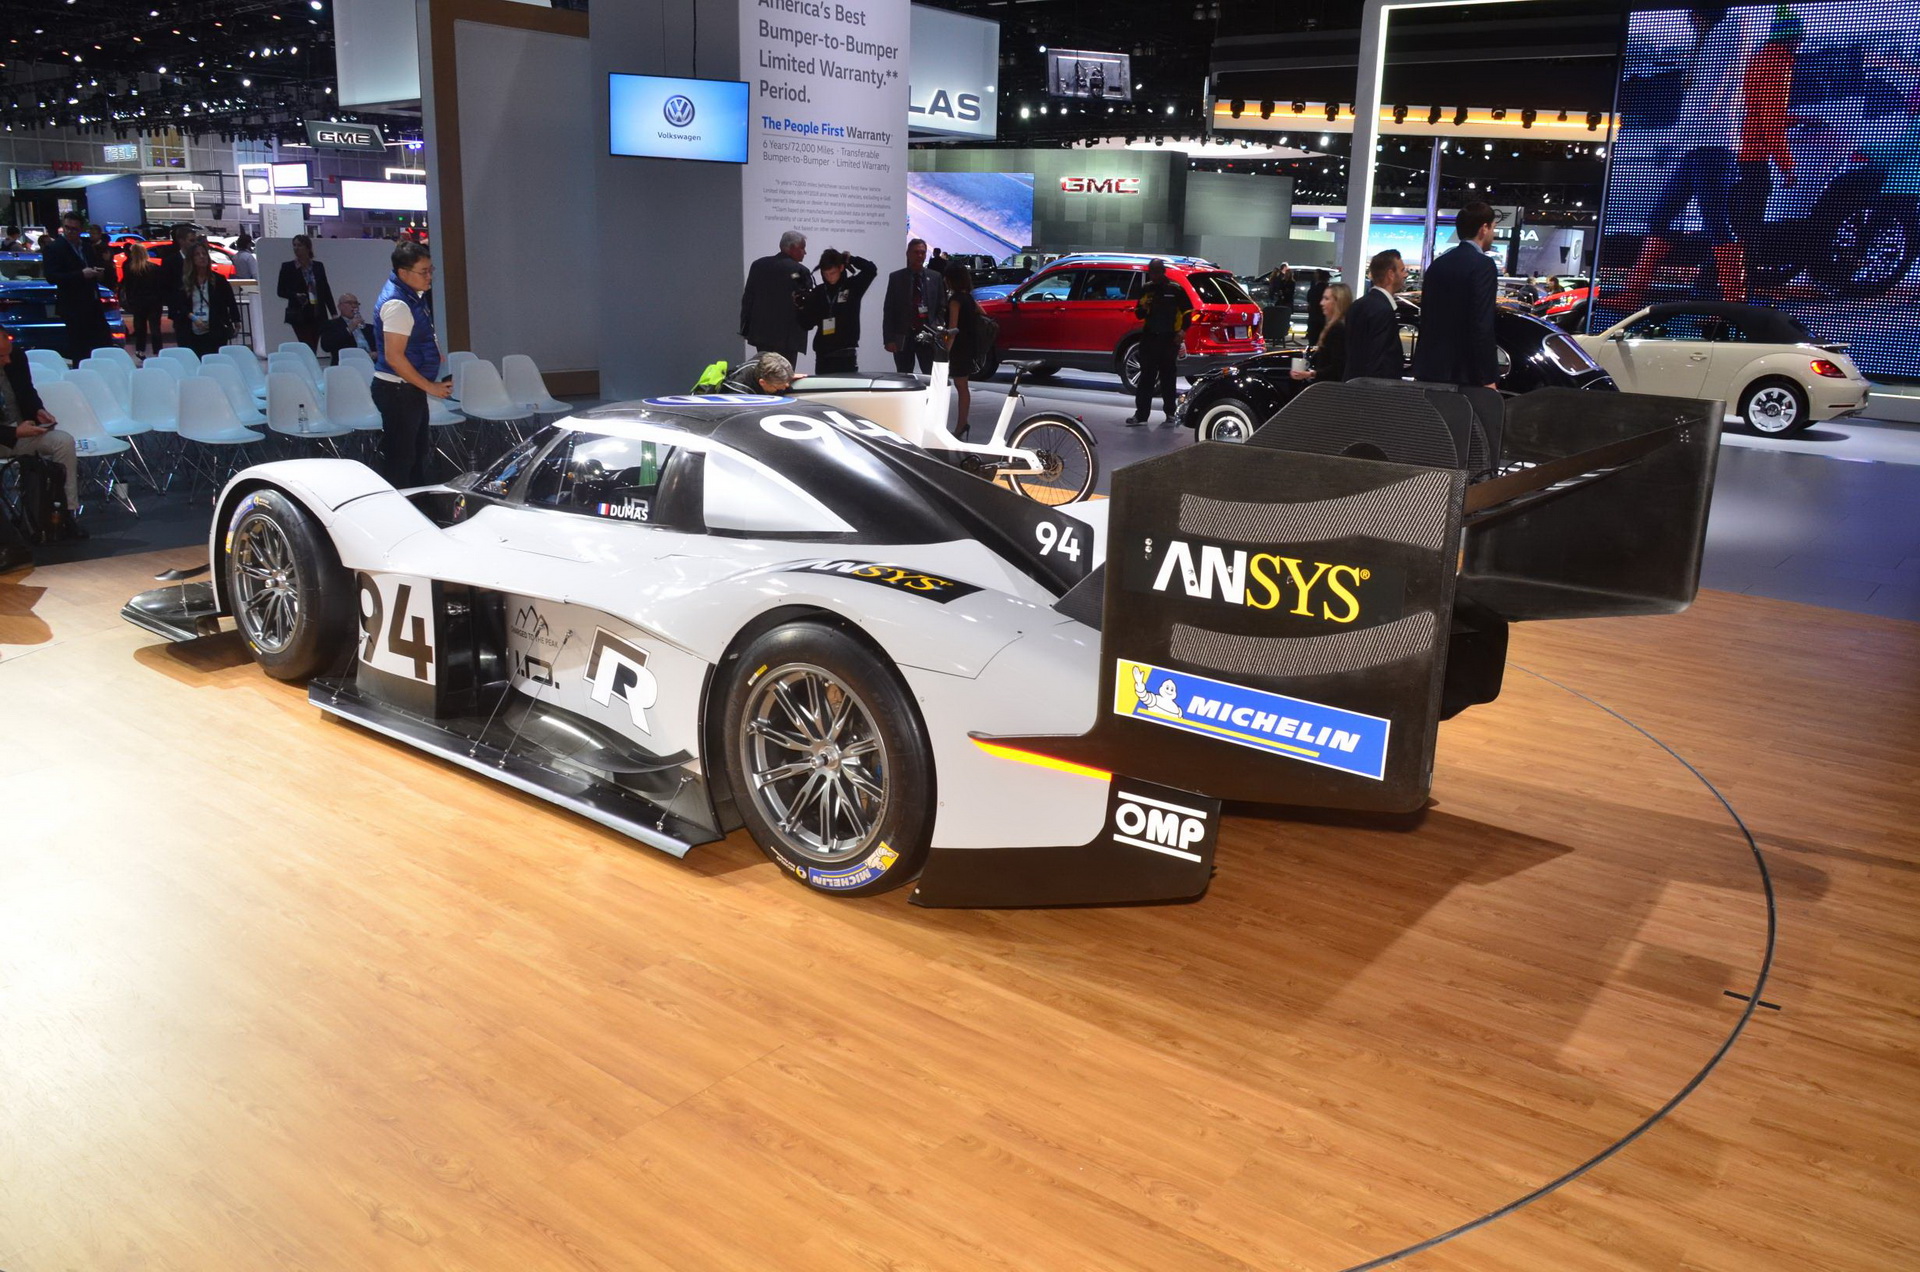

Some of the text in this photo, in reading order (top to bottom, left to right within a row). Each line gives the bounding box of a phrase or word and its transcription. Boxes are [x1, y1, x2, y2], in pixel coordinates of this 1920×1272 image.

[835, 4, 866, 26] Best
[759, 19, 899, 61] Bumper-to-Bumper
[759, 49, 815, 75] Limited
[760, 80, 811, 103] Period.
[909, 85, 981, 121] LAS
[317, 130, 371, 146] GMC
[657, 131, 702, 142] Volkswagen
[762, 116, 781, 130] The
[784, 119, 819, 136] People
[821, 123, 845, 138] First
[762, 139, 880, 160] 6 Years/72,000 Miles Transferable
[762, 151, 890, 173] Bumper-to-Bumper Limited Warranty
[1060, 177, 1140, 194] GMC
[610, 504, 648, 521] DUMAS
[1035, 521, 1080, 562] 94
[357, 571, 434, 681] 94
[584, 625, 658, 736] R
[1187, 696, 1360, 753] MICHELIN
[1115, 803, 1205, 850] OMP
[812, 869, 872, 887] MICHELIN
